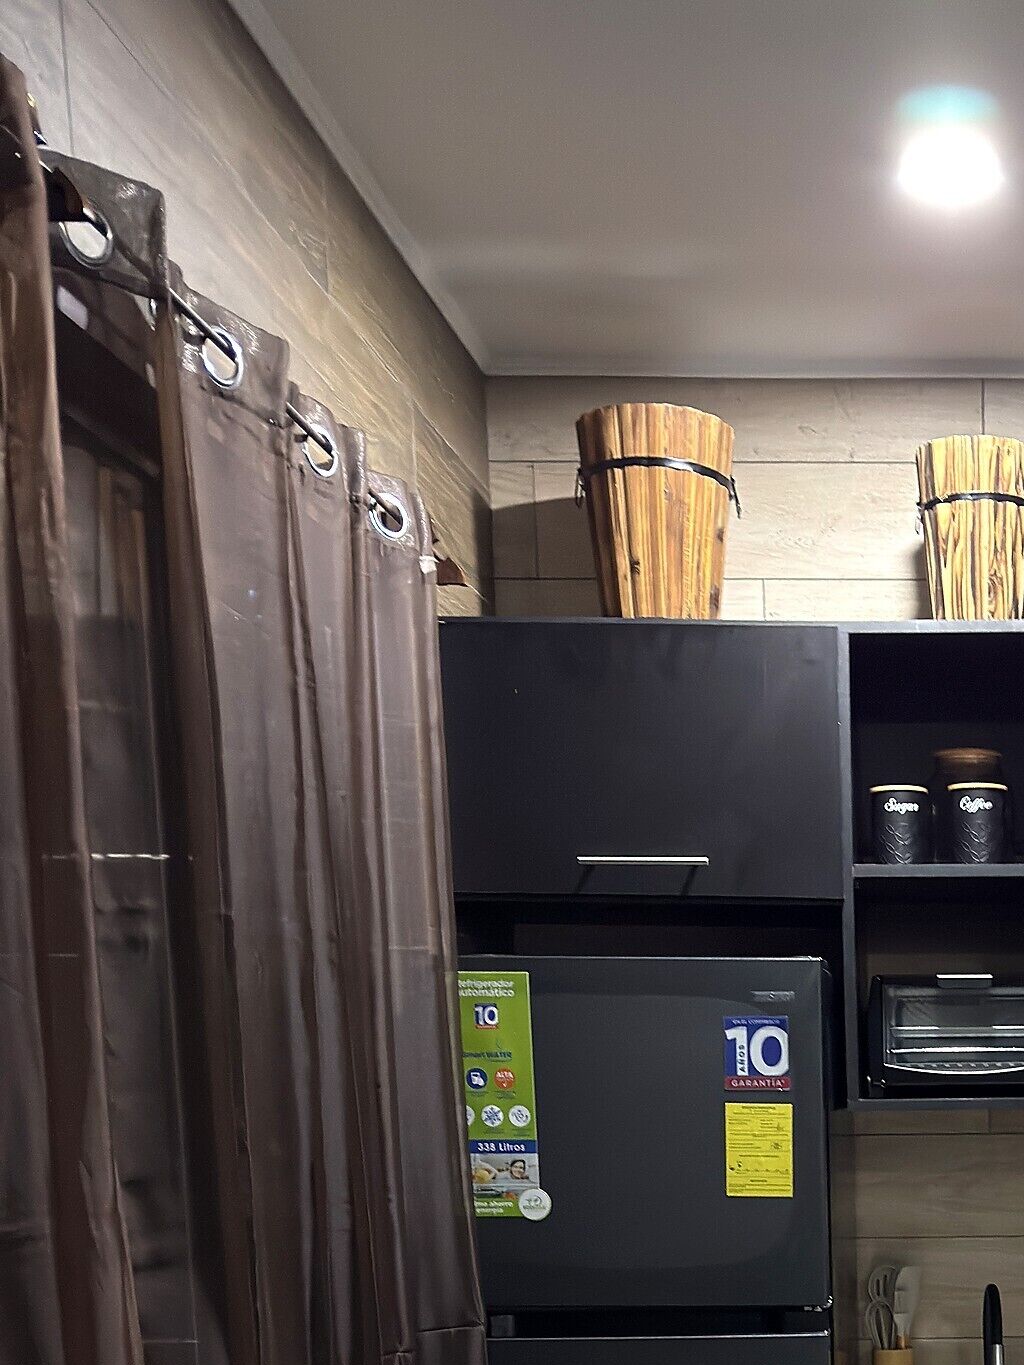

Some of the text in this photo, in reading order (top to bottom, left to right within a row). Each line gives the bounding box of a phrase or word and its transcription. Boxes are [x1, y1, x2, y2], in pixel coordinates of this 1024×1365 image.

[884, 798, 919, 814] Sugar
[959, 796, 993, 813] Coffee
[475, 1006, 499, 1025] 10
[725, 1025, 789, 1076] 10
[499, 1142, 526, 1152] Litros
